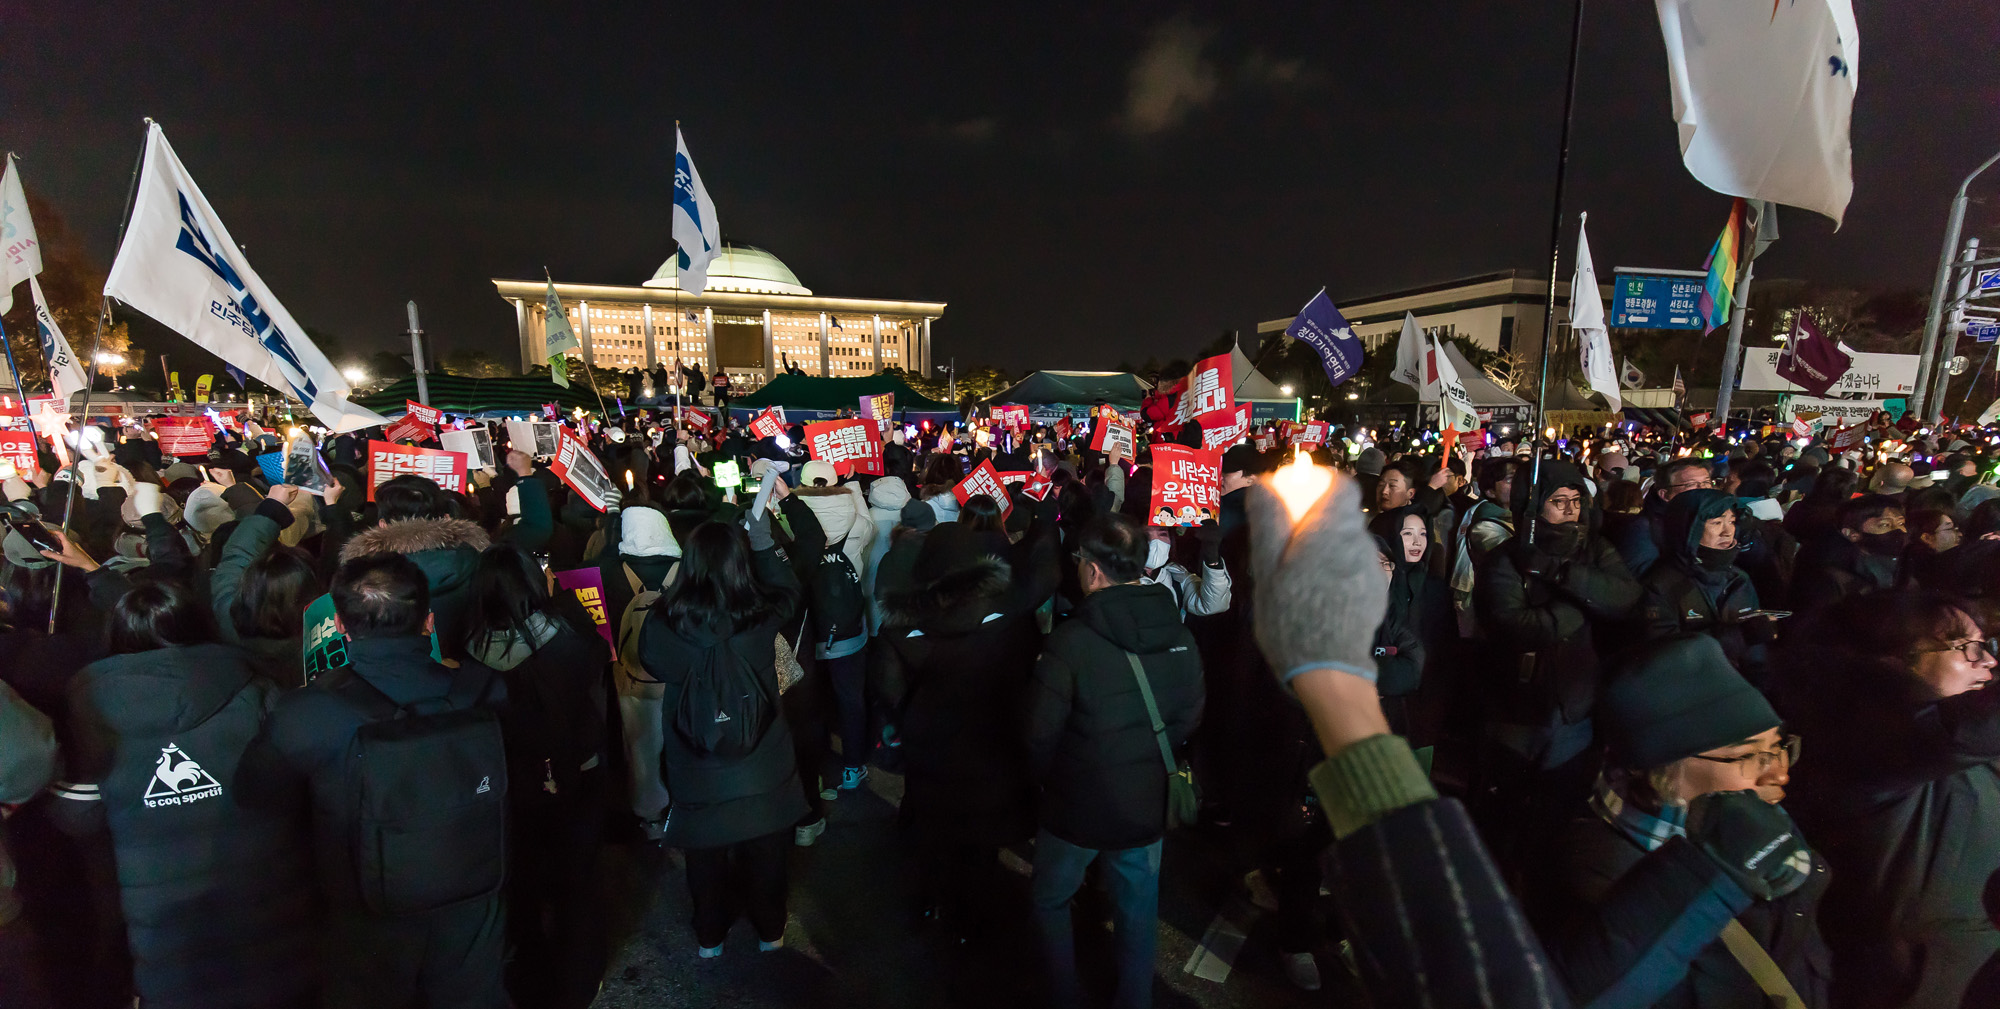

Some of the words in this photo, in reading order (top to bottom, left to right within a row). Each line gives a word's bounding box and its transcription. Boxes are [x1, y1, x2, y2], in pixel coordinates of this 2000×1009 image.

[210, 300, 255, 338] 민주당
[1297, 326, 1346, 379] 정의기억연대
[0, 441, 33, 455] 으로
[813, 425, 867, 452] 윤석열을
[374, 451, 454, 474] 김건희를
[817, 441, 873, 465] 거부한다!
[1171, 459, 1219, 487] 내란수괴
[980, 466, 1010, 513] 김건희를
[1162, 481, 1208, 505] 윤석열
[157, 796, 182, 807] coq
[181, 786, 223, 804] sportif
